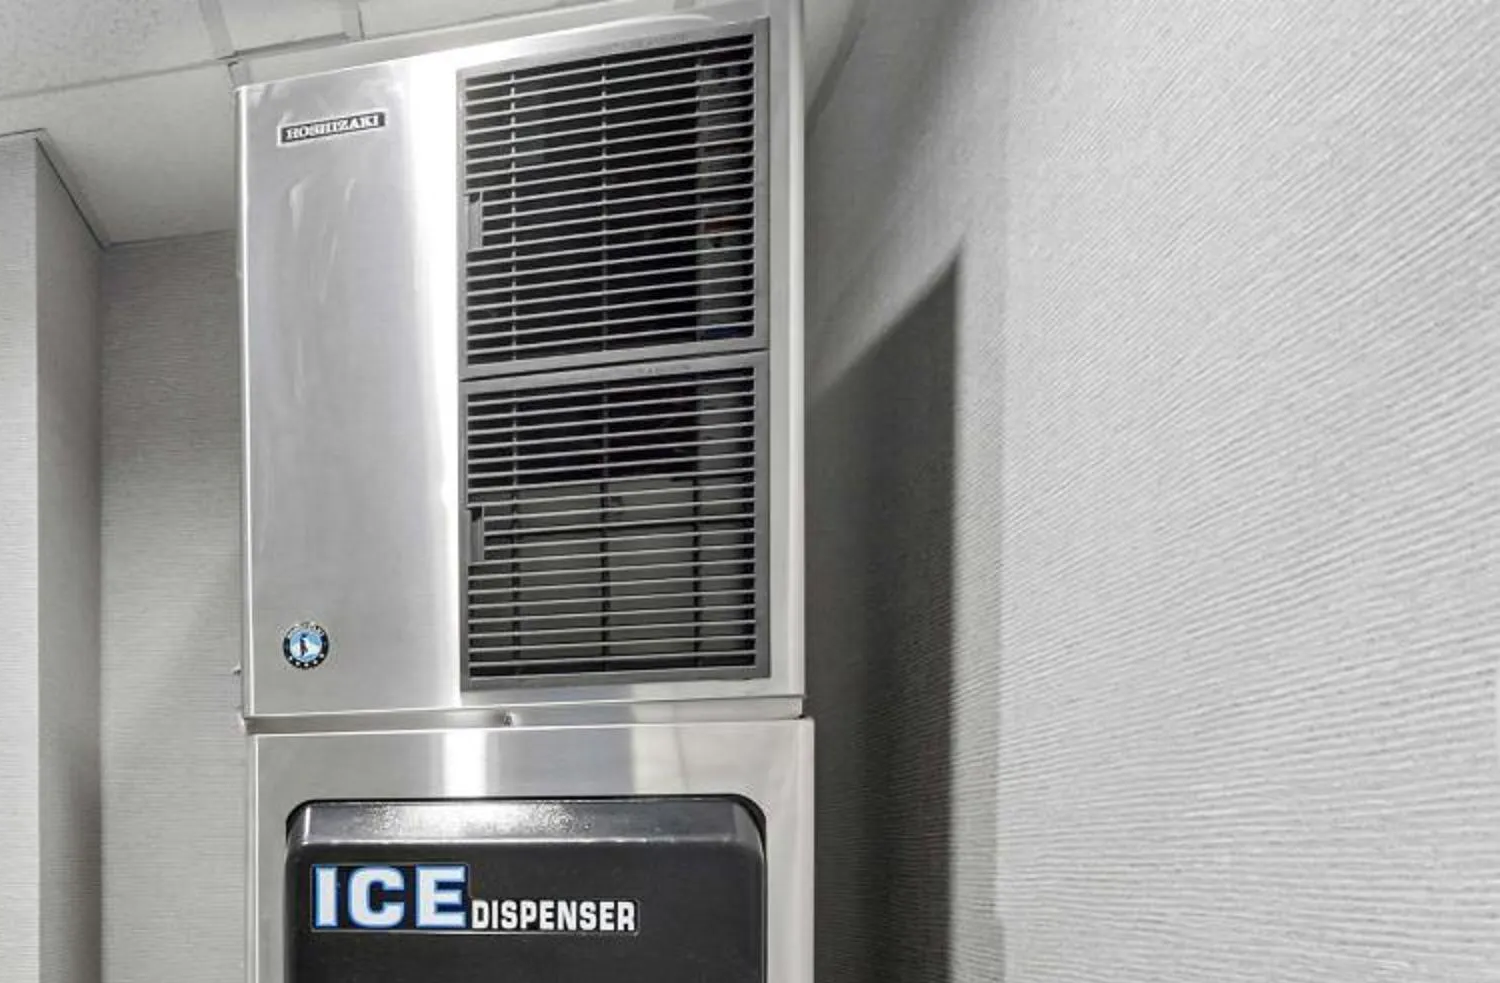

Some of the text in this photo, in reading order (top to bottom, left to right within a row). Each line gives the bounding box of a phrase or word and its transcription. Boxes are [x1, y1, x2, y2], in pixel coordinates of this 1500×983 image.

[285, 116, 380, 140] HOSHIZAKI
[313, 865, 636, 931] ICE DISPENSER
